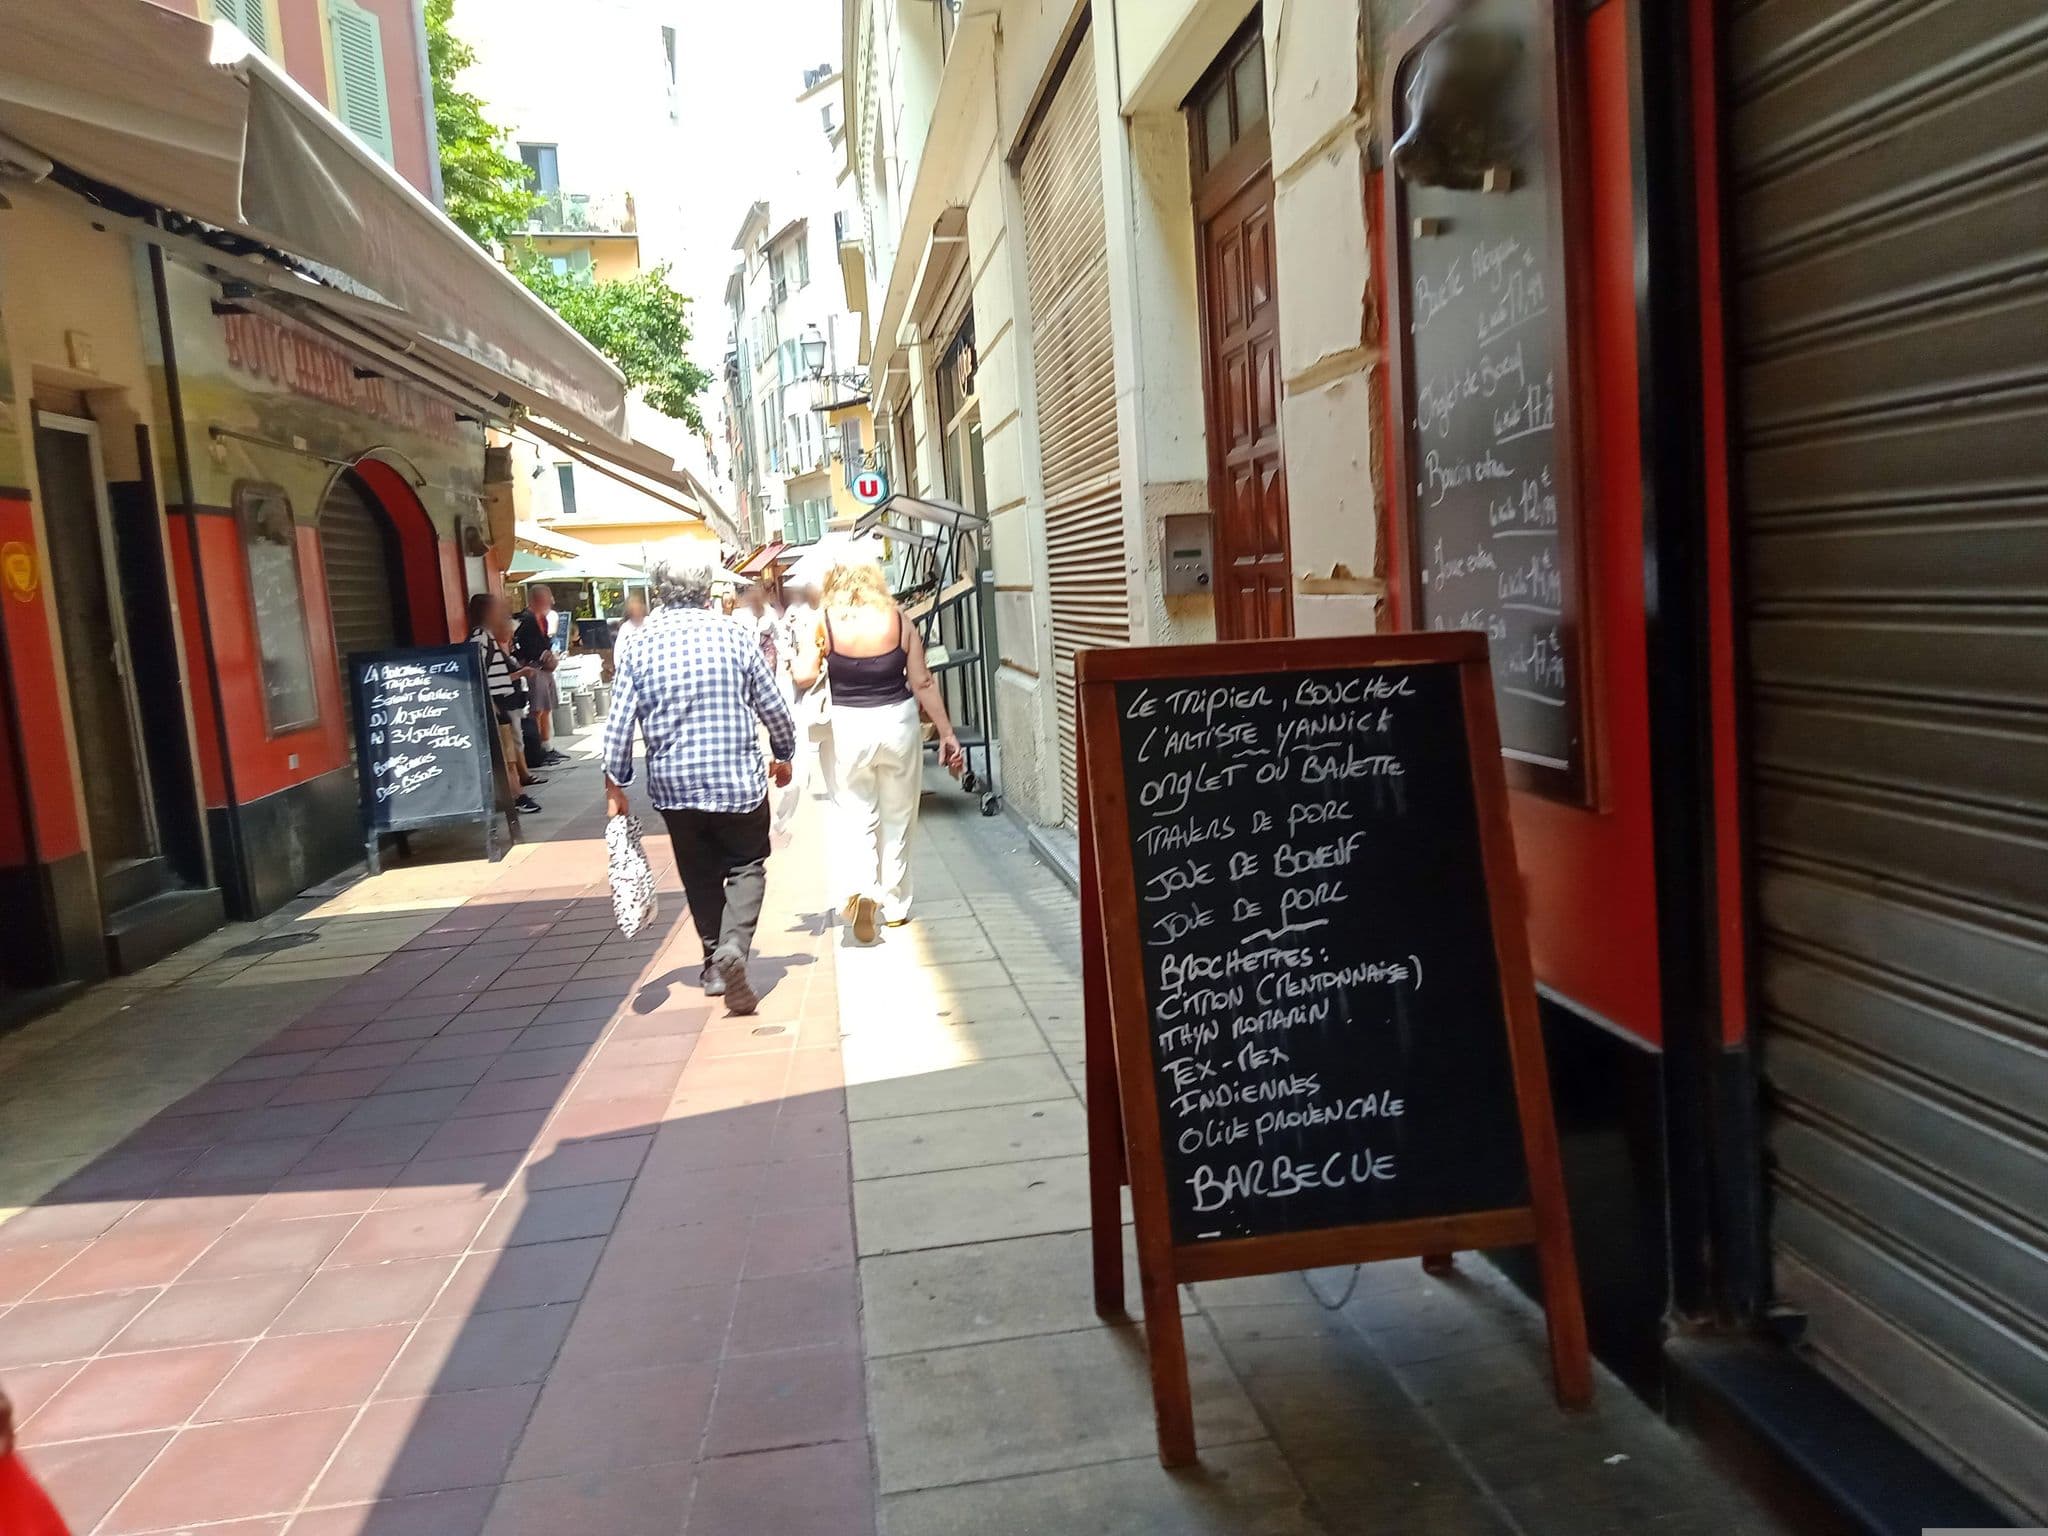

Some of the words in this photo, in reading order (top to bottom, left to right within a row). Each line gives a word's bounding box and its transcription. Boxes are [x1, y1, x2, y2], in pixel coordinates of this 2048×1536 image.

[859, 480, 878, 497] U
[429, 662, 446, 674] ET
[444, 660, 460, 673] LA
[369, 710, 388, 727] DU
[389, 705, 407, 726] 10
[1126, 688, 1159, 719] LE
[1295, 675, 1416, 706] BOUCHER
[391, 726, 412, 744] 31
[1138, 722, 1258, 763] L'ARTISTE
[1277, 707, 1394, 758] YANNICK
[1140, 762, 1248, 817] ONGLET
[1256, 756, 1290, 784] OU
[1300, 743, 1406, 784] BAVETTE
[1137, 815, 1236, 856] TRAVERS
[1251, 810, 1272, 834] DE
[1287, 800, 1353, 839] PORC
[1144, 859, 1216, 902] JOUE
[1228, 851, 1260, 881] DE
[1148, 901, 1215, 946] JOUE
[1232, 898, 1262, 922] DE
[1280, 881, 1349, 930] PORC
[1156, 984, 1244, 1021] CITRON
[1231, 997, 1330, 1040] ROMARIN
[1169, 1072, 1321, 1118] INDIENNES
[1178, 1117, 1250, 1154] OLIVE
[1185, 1148, 1397, 1212] BARBECUE
